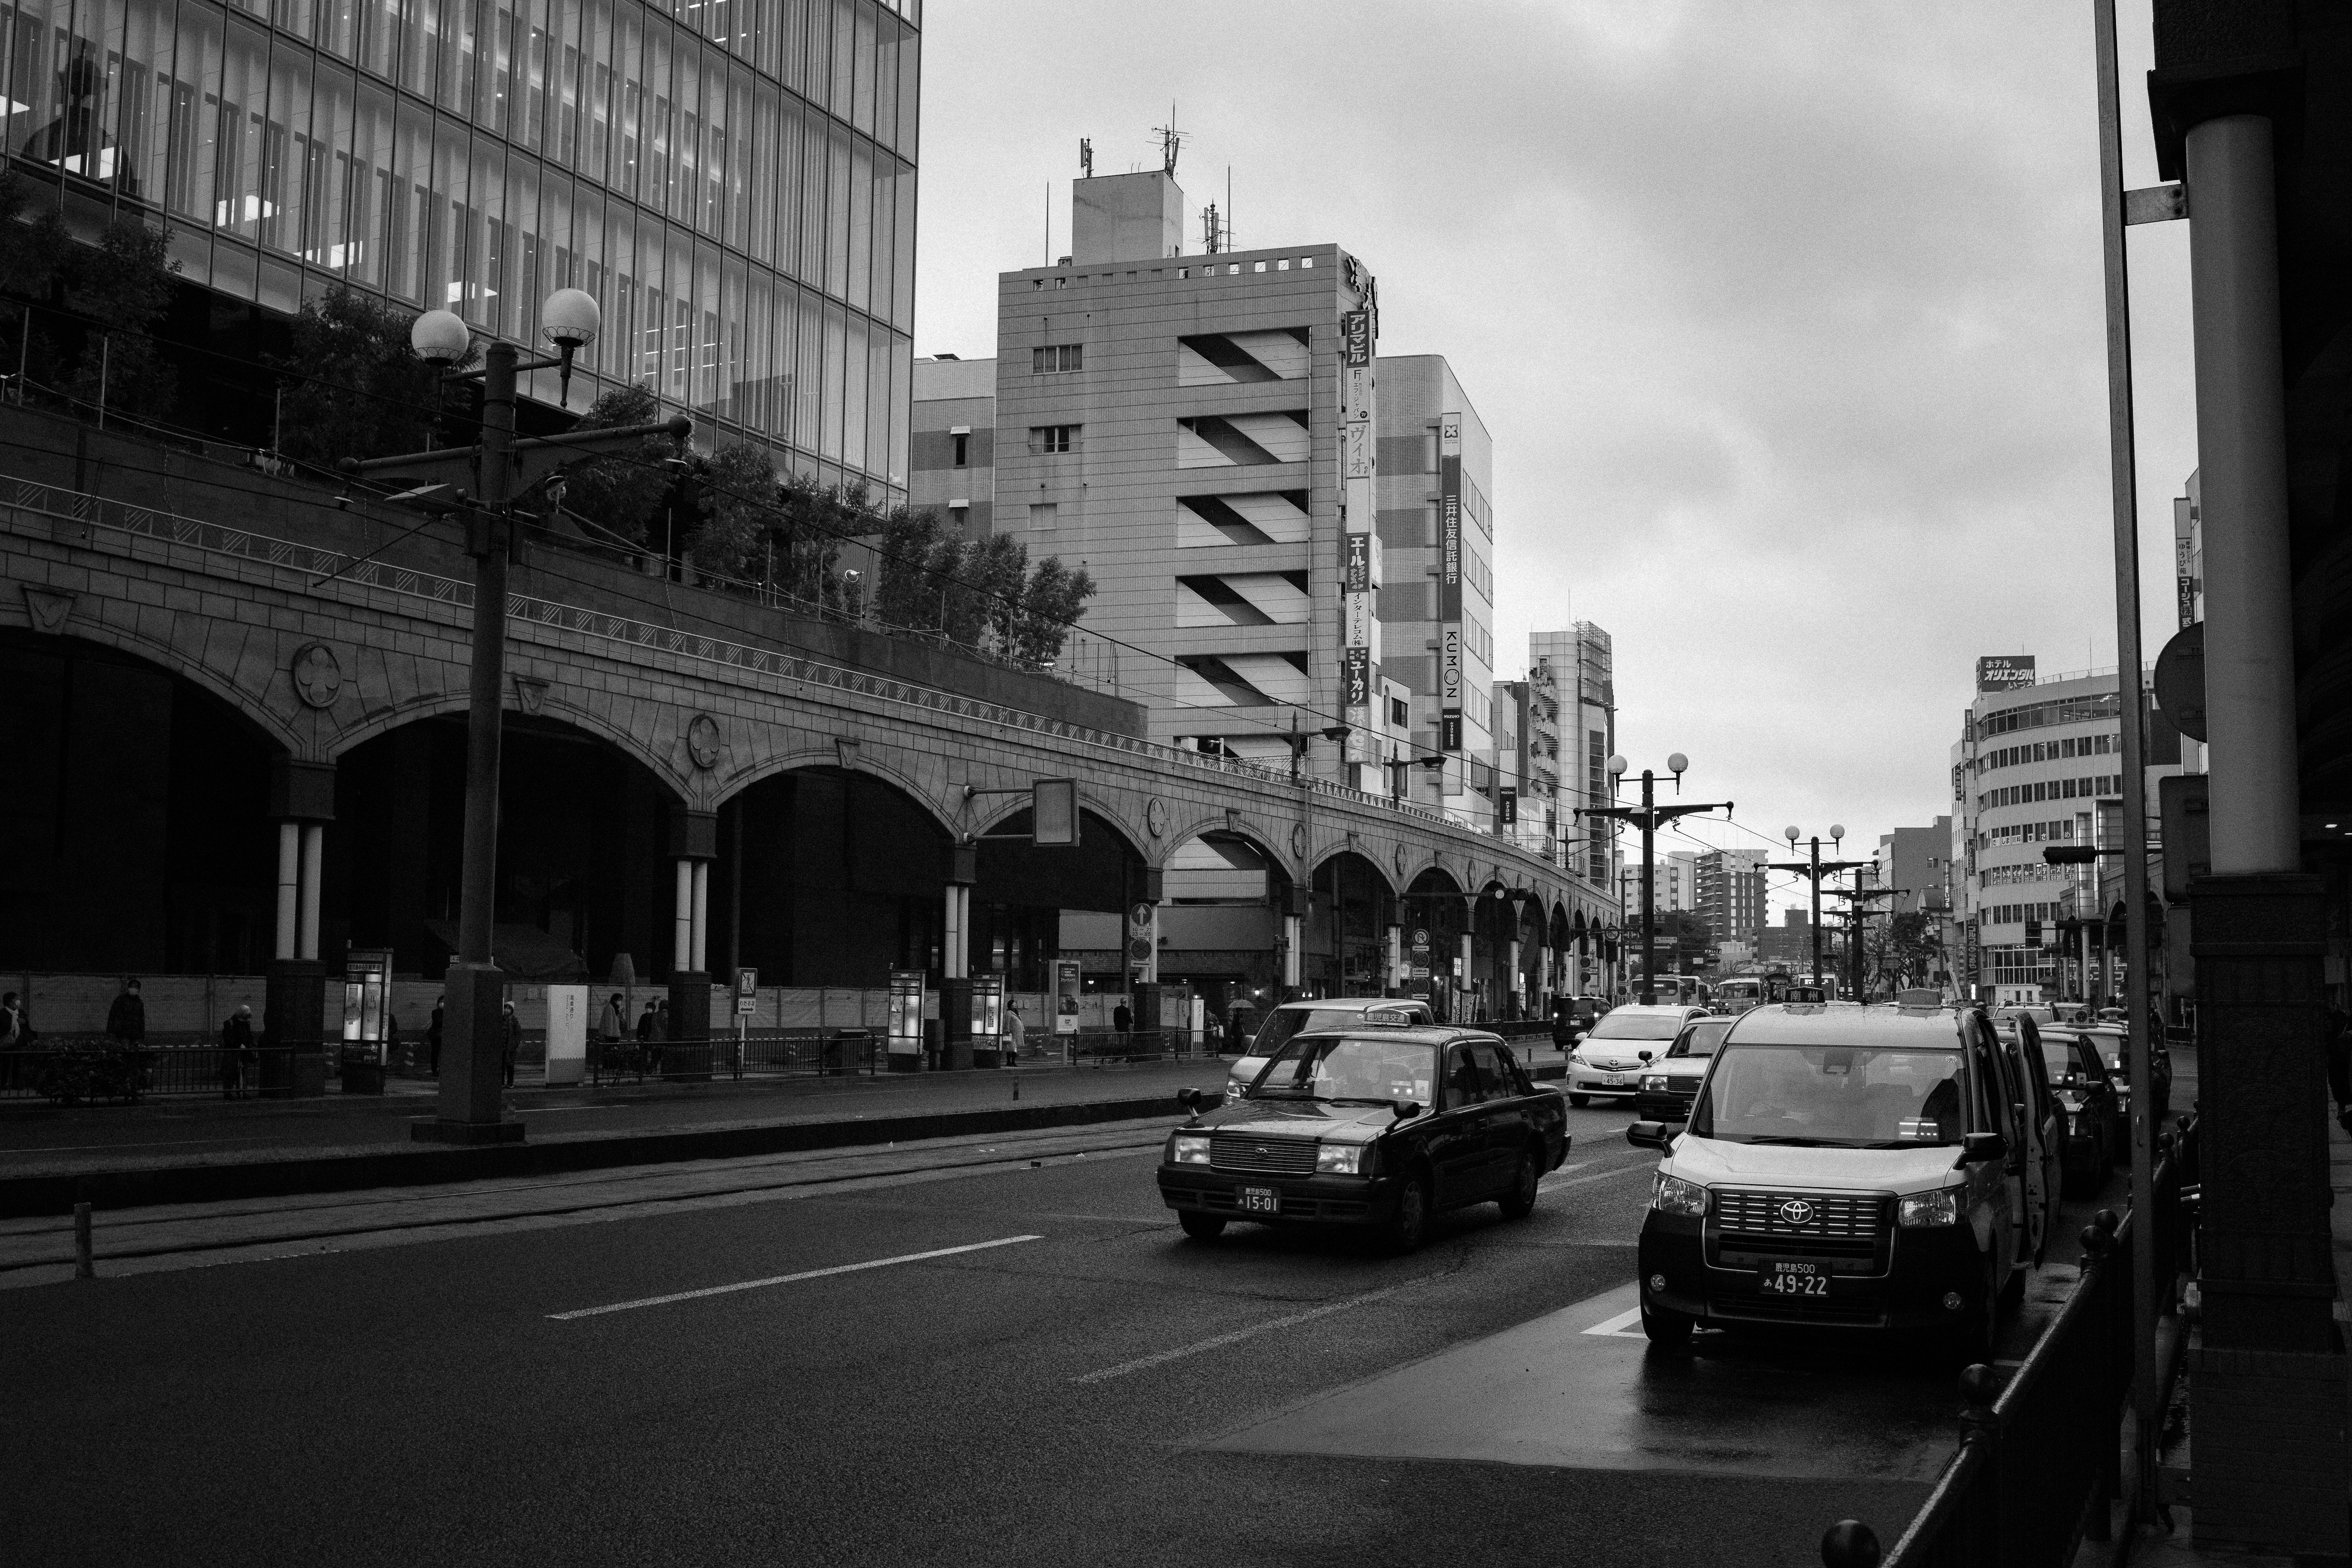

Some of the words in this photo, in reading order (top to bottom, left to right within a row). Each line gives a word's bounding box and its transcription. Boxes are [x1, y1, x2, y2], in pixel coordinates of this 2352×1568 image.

[1350, 314, 1366, 363] アリマビル
[1349, 425, 1366, 474] ヴィオ
[1351, 537, 1365, 566] エール
[1446, 495, 1457, 584] 三井住友信託銀行
[1444, 632, 1459, 697] KUMON
[1984, 669, 2034, 681] オリエンタル
[1986, 660, 2011, 668] ホテル
[1351, 662, 1364, 704] ユーカリ
[1367, 1013, 1405, 1022] 鹿児島交通
[1247, 1196, 1277, 1211] 15-01
[1764, 1279, 1772, 1287] あ
[1775, 1274, 1827, 1295] 49-22
